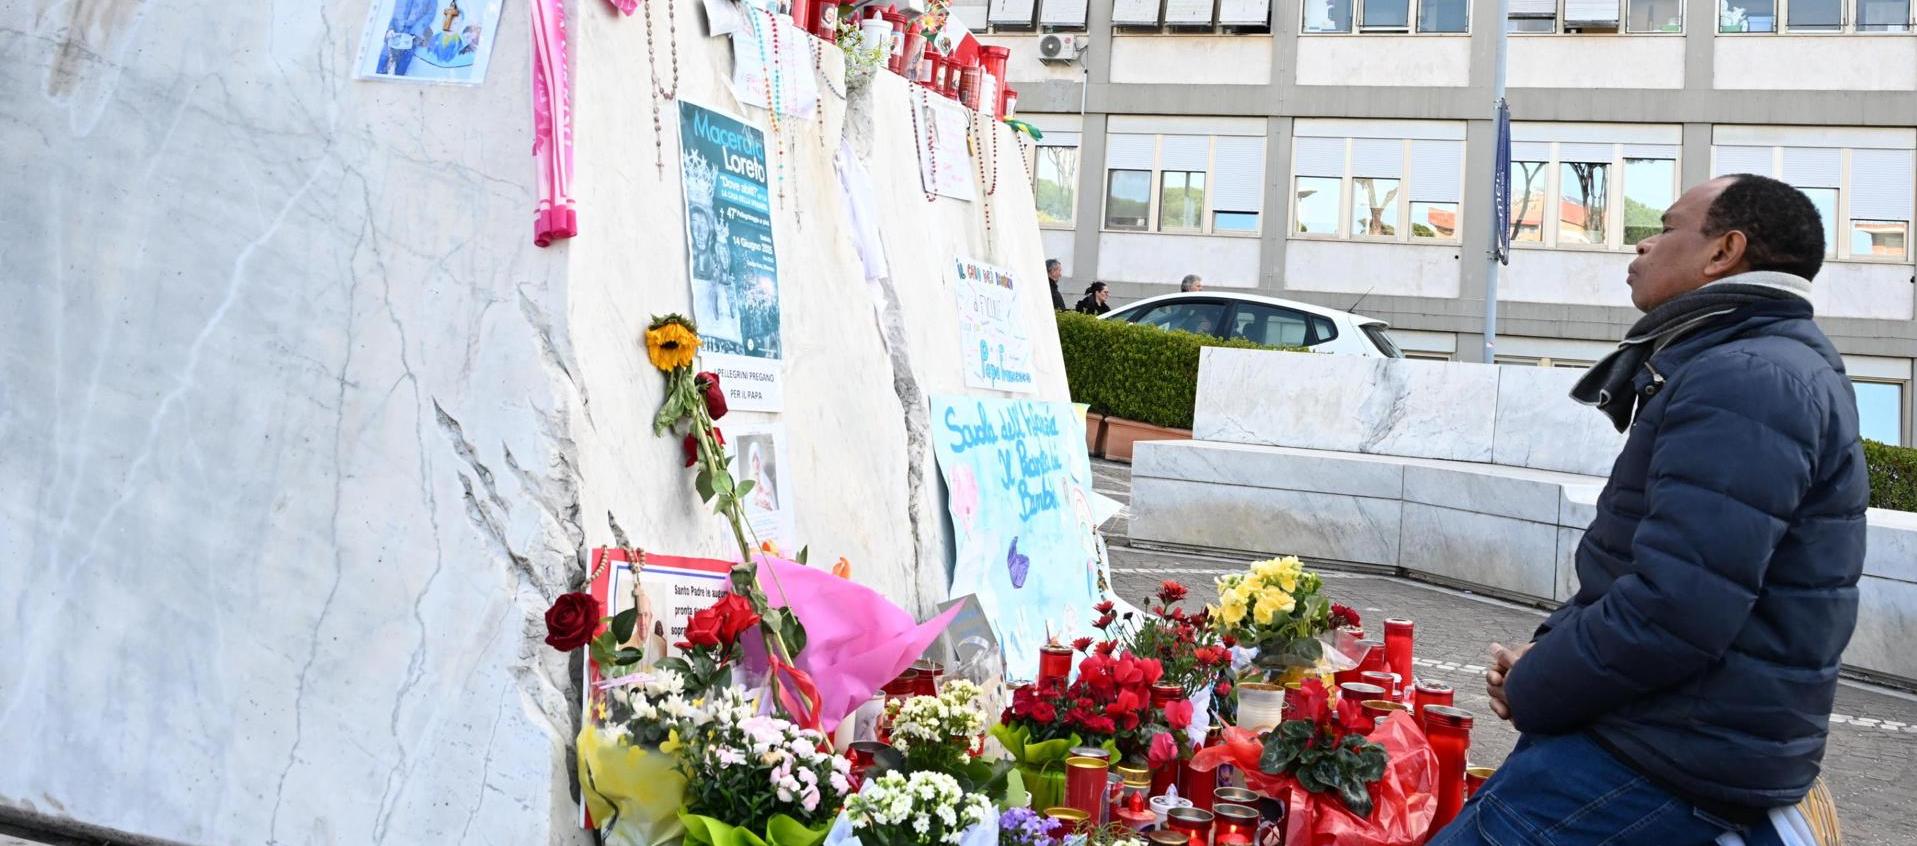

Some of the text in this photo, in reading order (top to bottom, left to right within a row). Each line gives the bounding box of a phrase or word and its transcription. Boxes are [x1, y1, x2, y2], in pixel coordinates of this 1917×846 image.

[694, 110, 764, 164] Macerata
[721, 145, 766, 183] Loreto
[740, 237, 762, 252] Giugno
[717, 368, 748, 380] PELLEGRINI
[749, 371, 775, 383] PREGANO
[730, 389, 763, 400] PER IL PAPA
[674, 584, 690, 595] Santo
[690, 585, 705, 597] Padre
[674, 606, 693, 618] pronta
